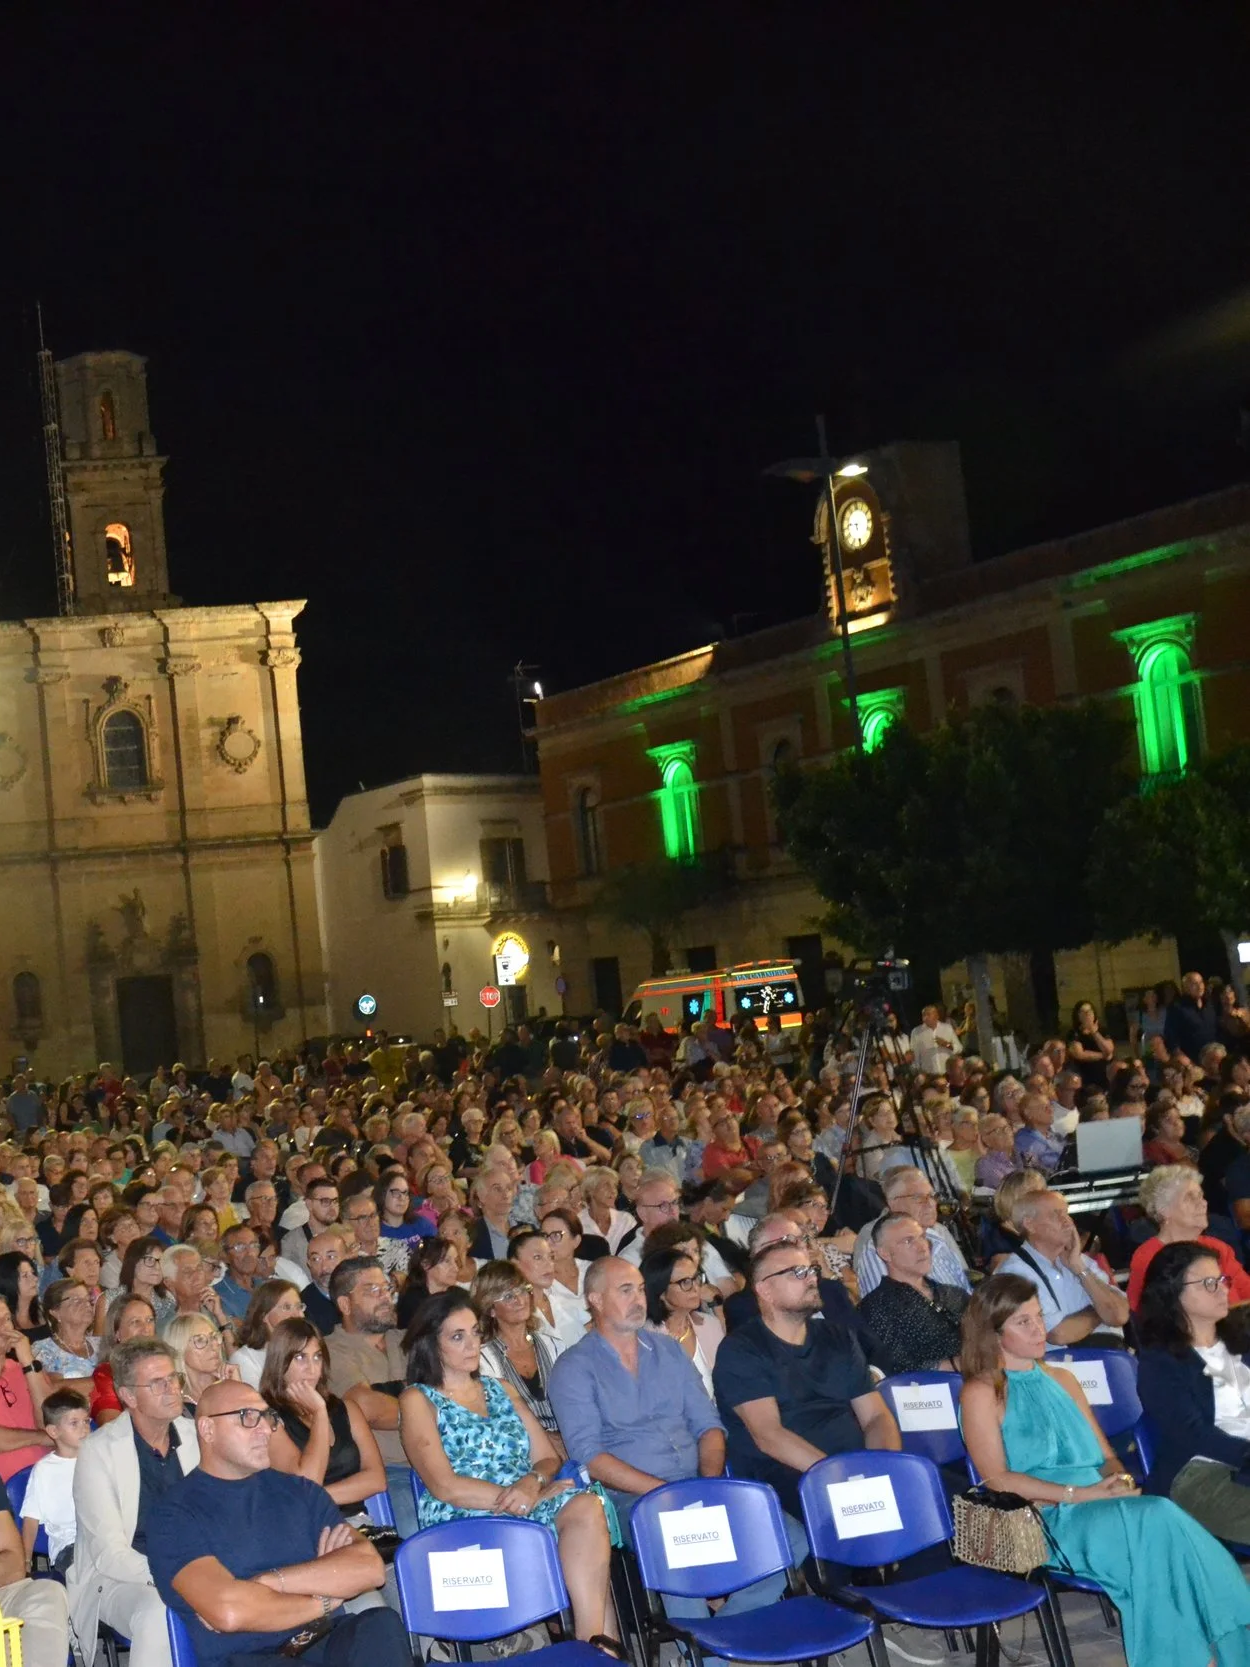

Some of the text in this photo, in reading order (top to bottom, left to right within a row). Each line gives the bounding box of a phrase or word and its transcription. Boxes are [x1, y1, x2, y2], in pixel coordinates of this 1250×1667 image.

[481, 992, 499, 1000] STOP
[903, 1400, 943, 1409] RISERVATO
[841, 1500, 886, 1515] RISERVATO
[672, 1531, 720, 1544] RISERVATO
[442, 1575, 493, 1586] RISERVATO
